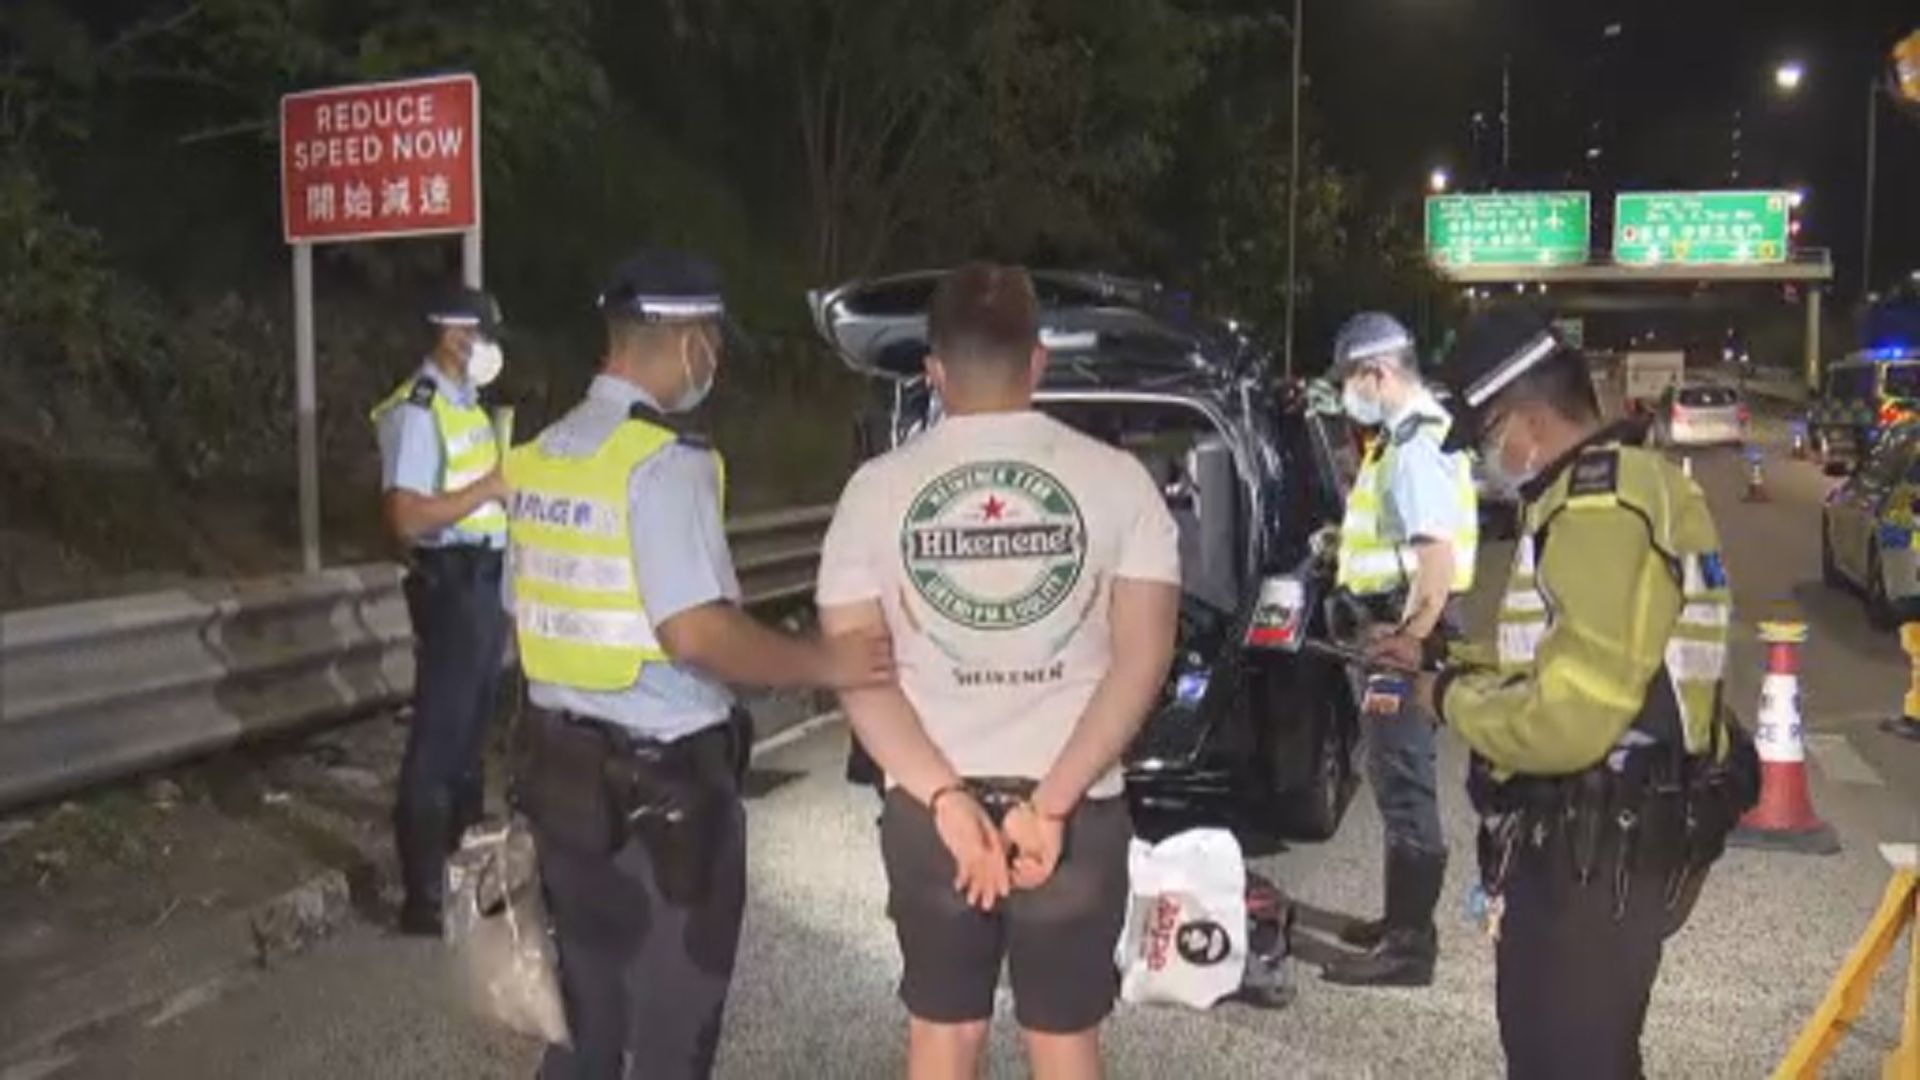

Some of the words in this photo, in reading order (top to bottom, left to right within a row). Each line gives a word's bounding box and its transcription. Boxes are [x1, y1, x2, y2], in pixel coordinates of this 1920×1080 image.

[316, 95, 433, 132] REDUCE
[294, 134, 382, 170] SPEED
[393, 127, 462, 163] NOW
[307, 174, 450, 221] 開始減速
